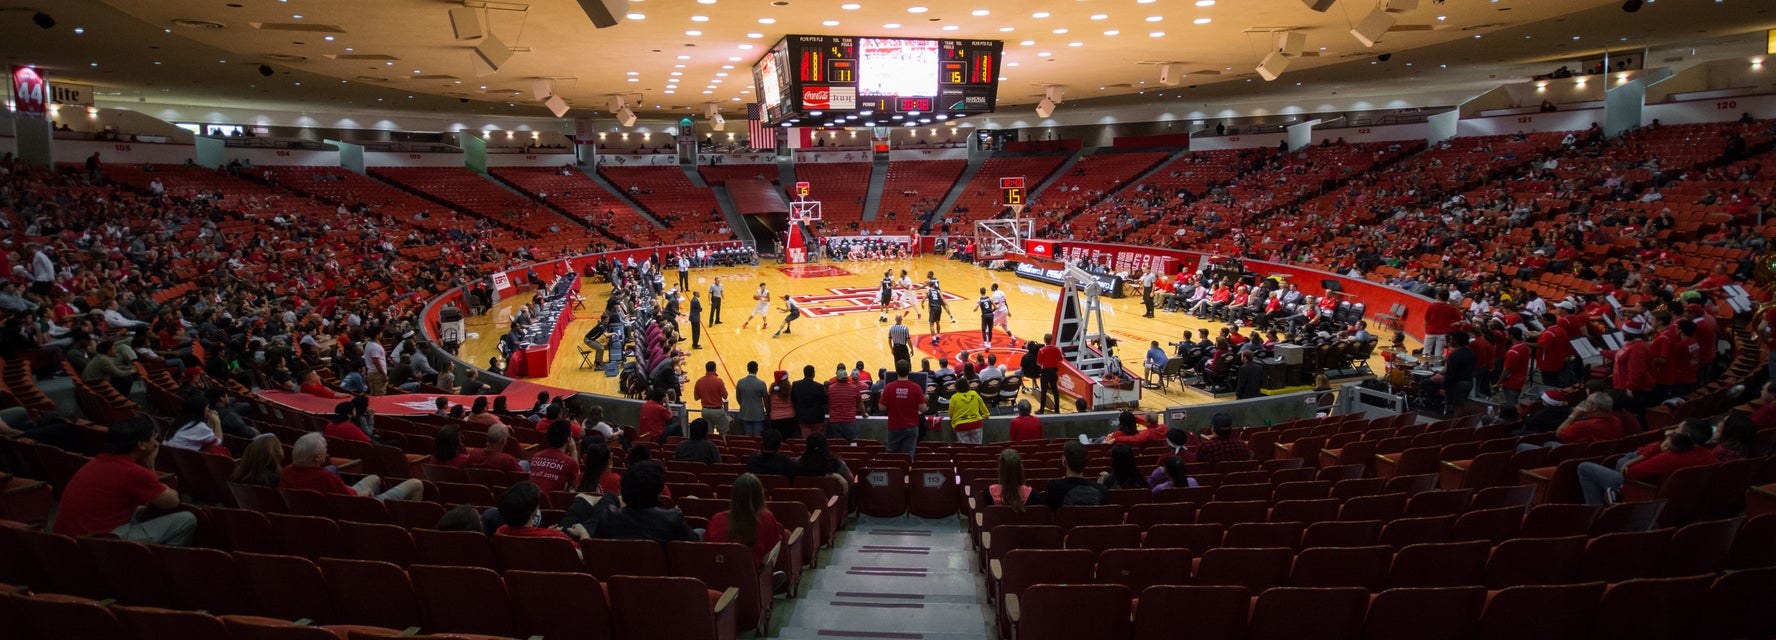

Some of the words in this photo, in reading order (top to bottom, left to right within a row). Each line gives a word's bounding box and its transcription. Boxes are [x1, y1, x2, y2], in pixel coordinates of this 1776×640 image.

[959, 49, 964, 57] 4
[841, 70, 850, 81] 11
[951, 72, 960, 83] 15
[18, 82, 42, 104] 44
[1717, 101, 1736, 110] 120
[682, 126, 691, 136] 13
[1009, 189, 1020, 203] 15
[531, 460, 563, 470] OUSTON
[544, 472, 559, 480] 2019
